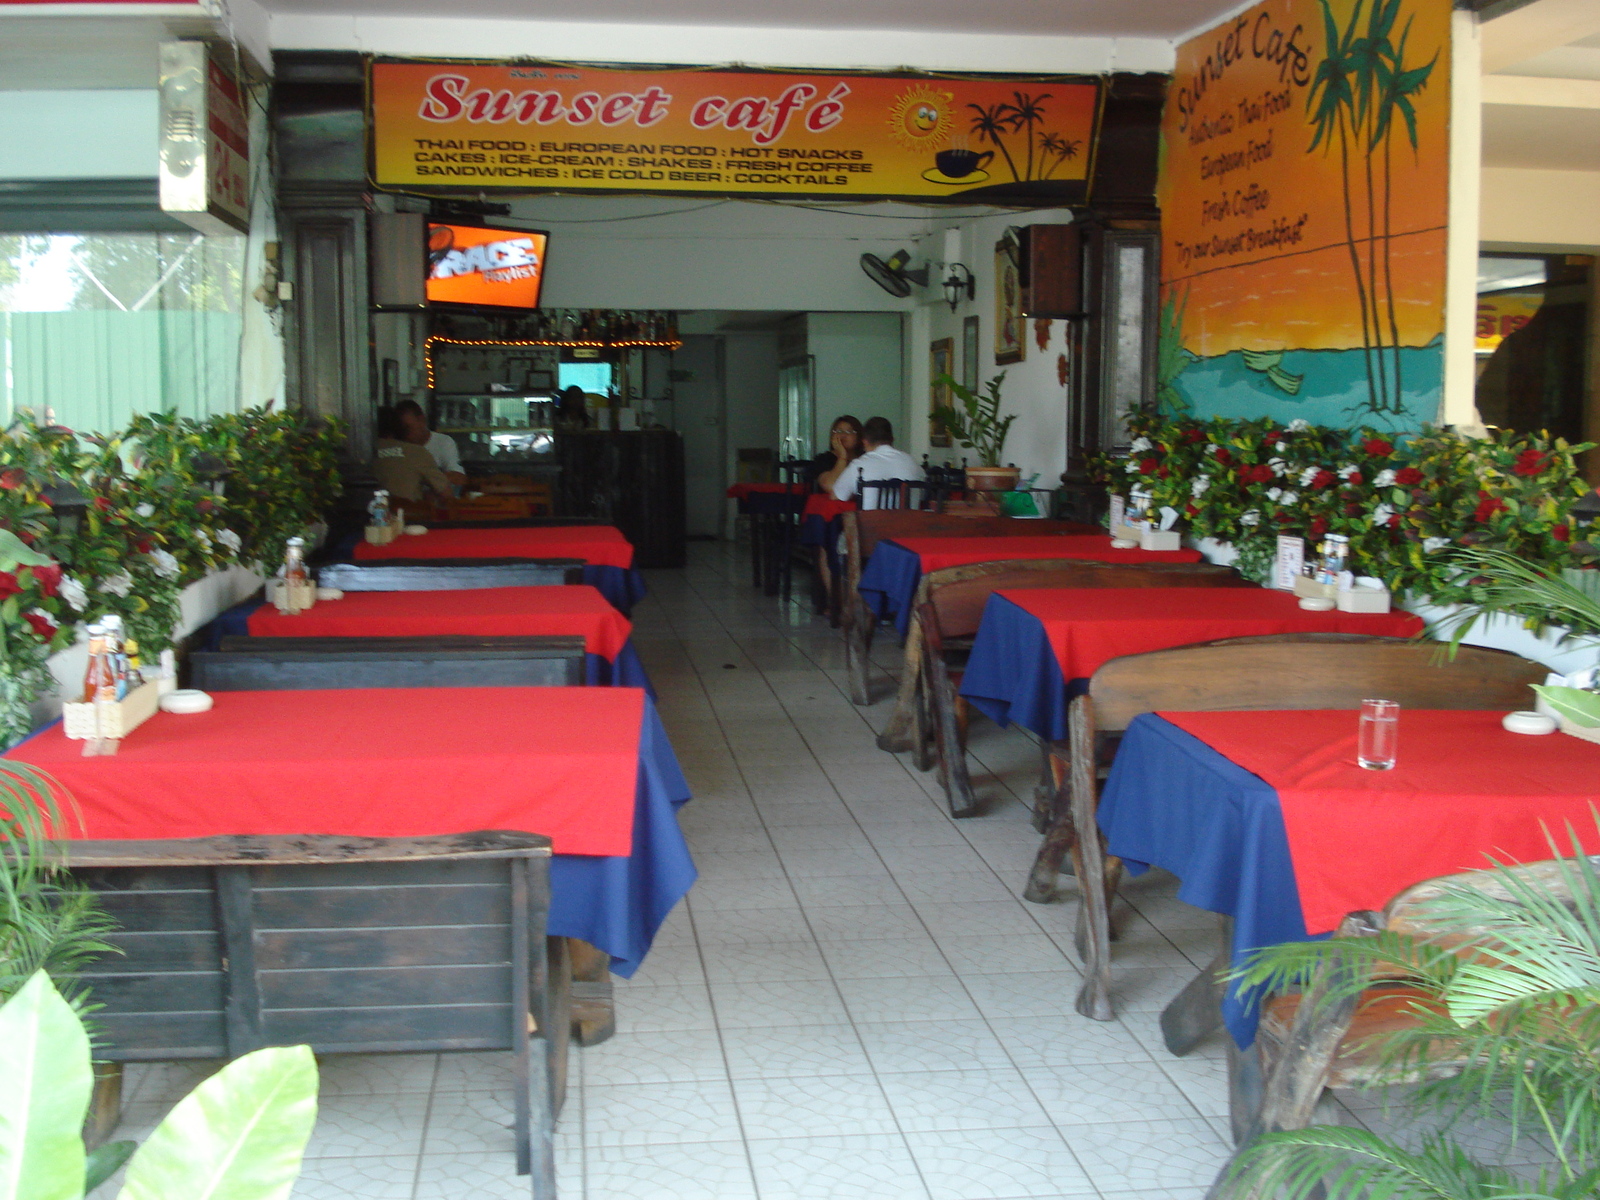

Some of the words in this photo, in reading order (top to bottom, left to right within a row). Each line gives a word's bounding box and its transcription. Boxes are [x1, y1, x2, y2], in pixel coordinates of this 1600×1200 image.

[1177, 16, 1249, 133] Sunset
[418, 74, 672, 128] Sunset
[690, 81, 852, 146] café
[414, 139, 464, 150] THAI
[468, 140, 526, 152] FOOD
[540, 141, 656, 155] EUROPEAN
[660, 145, 717, 157] FOOD
[730, 147, 774, 159] HOT
[777, 148, 864, 160] SNACKS
[414, 152, 486, 163] CAKES
[500, 154, 614, 166] ICE-CREAM
[628, 156, 712, 169] SHAKES
[725, 160, 792, 171] FRESH
[796, 162, 873, 173] COFFEE
[416, 165, 559, 178] SANDWICHES
[572, 168, 604, 179] ICE
[608, 169, 664, 181] COLD
[669, 171, 722, 183] BEER
[734, 173, 848, 185] COCKTAILS
